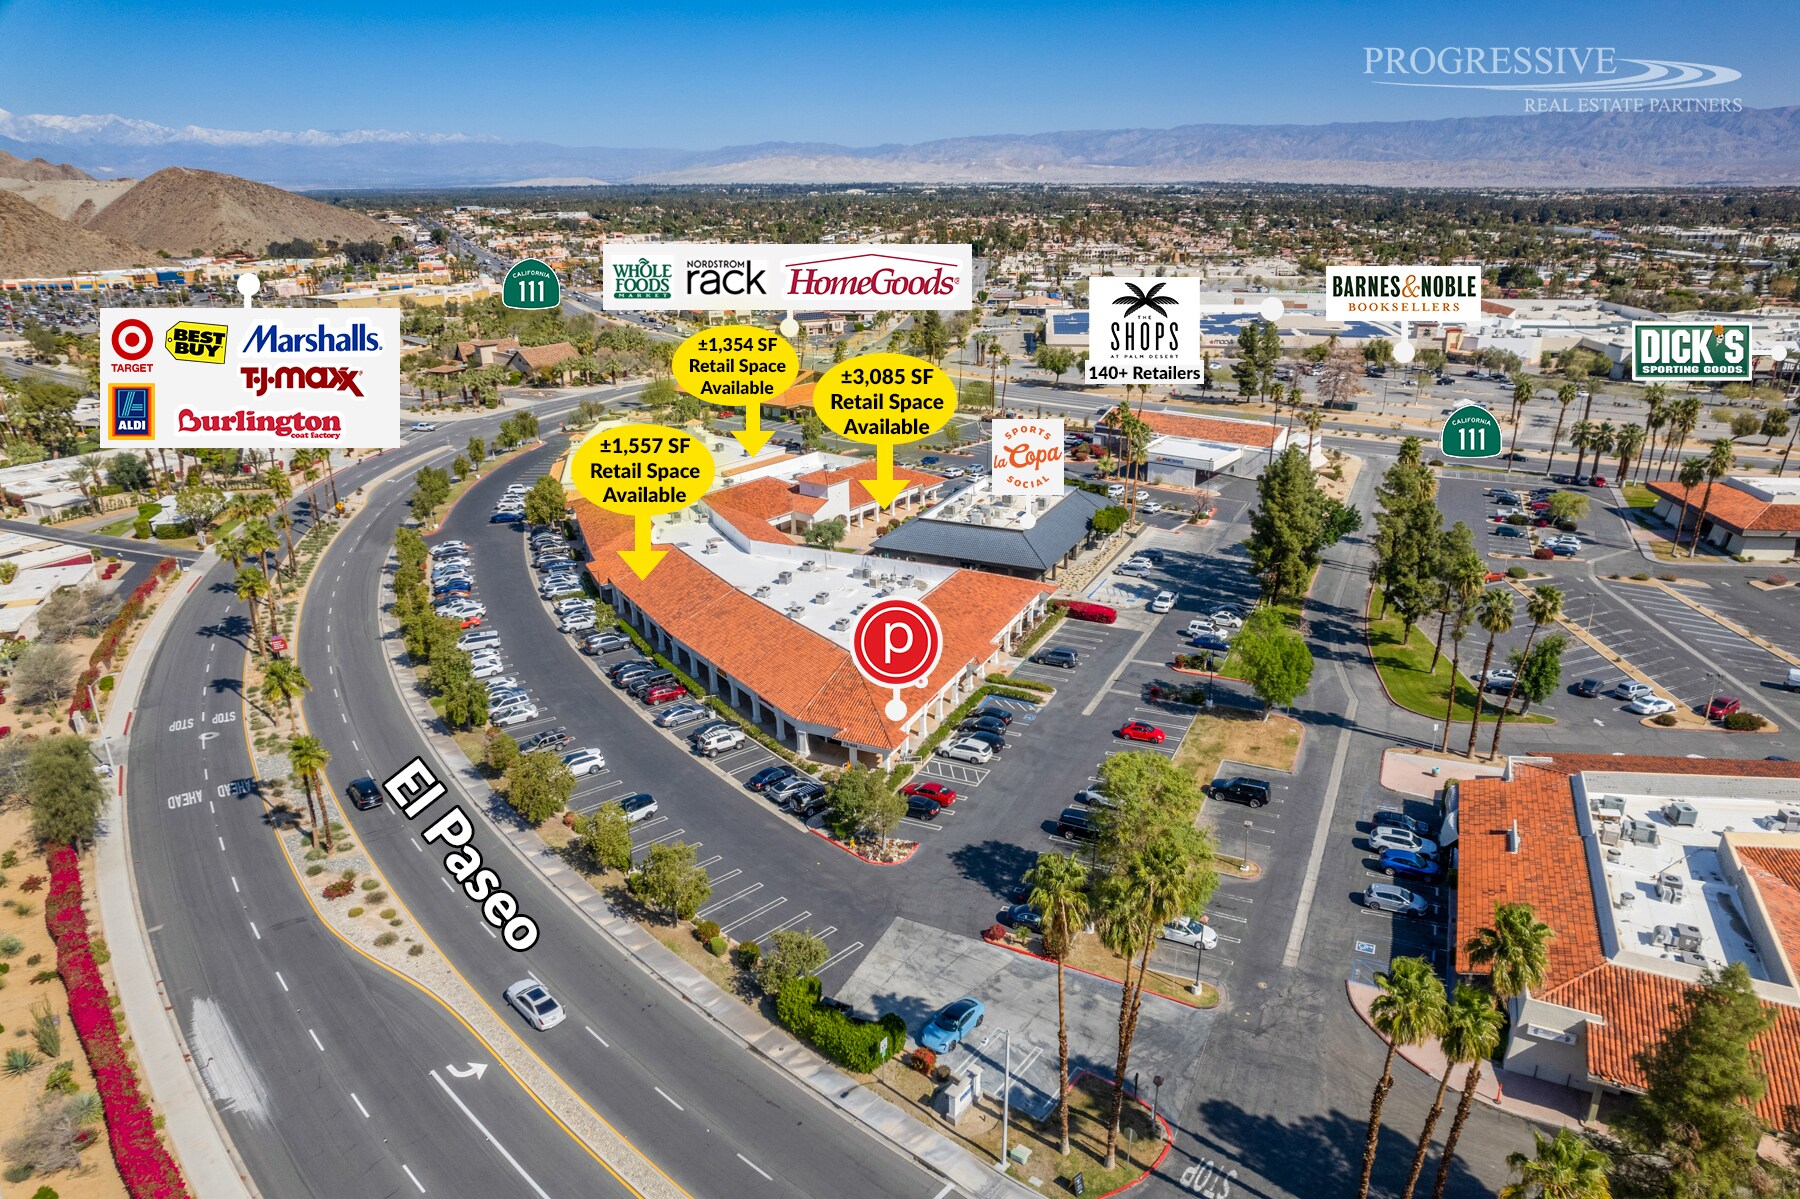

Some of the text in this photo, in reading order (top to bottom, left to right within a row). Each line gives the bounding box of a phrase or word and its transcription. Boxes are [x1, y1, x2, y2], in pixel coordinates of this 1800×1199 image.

[169, 718, 194, 732] STOP
[211, 711, 236, 724] STOP
[217, 779, 251, 798] AHEAD
[167, 789, 202, 809] AHEAD
[1180, 1157, 1238, 1199] STOP
